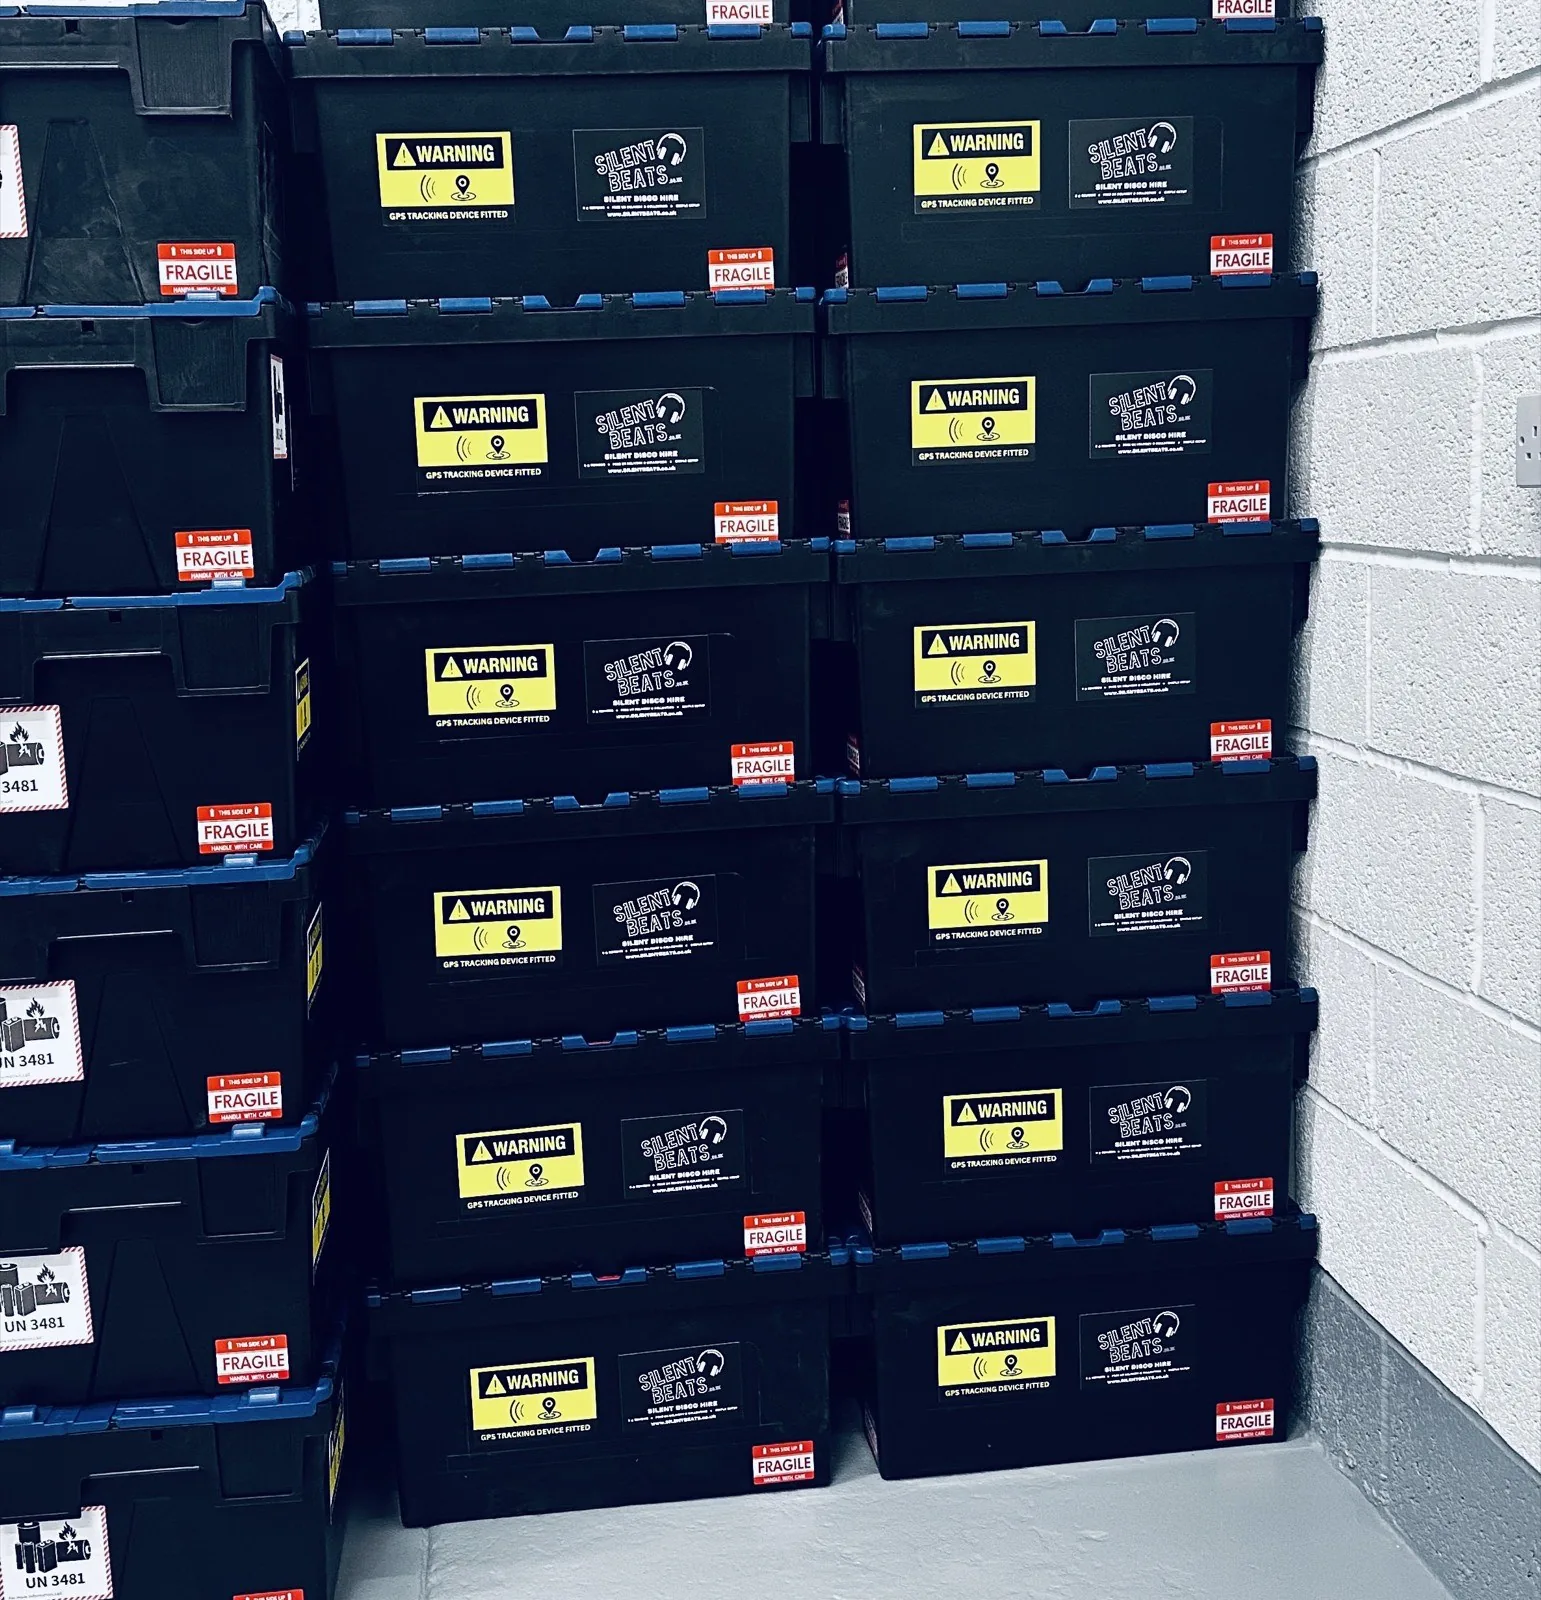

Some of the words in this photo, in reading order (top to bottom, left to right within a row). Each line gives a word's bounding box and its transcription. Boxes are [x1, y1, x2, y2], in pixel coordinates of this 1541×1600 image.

[712, 5, 769, 19] FRAGILE
[1218, 0, 1272, 13] FRAGILE
[950, 133, 1024, 152] WARNING
[416, 144, 495, 162] WARNING
[1101, 153, 1158, 180] BEATS
[608, 165, 668, 192] BEATS
[921, 200, 937, 208] GPS
[938, 199, 977, 207] TRACKING
[978, 198, 1006, 206] DEVICE
[1007, 197, 1033, 205] FITTED
[389, 212, 406, 220] GPS
[407, 212, 448, 220] TRACKING
[450, 211, 479, 219] DEVICE
[480, 210, 508, 218] FITTED
[1216, 253, 1269, 267] FRAGILE
[166, 265, 233, 280] FRAGILE
[714, 267, 770, 282] FRAGILE
[947, 388, 1019, 406] WARNING
[452, 406, 529, 424] WARNING
[1121, 404, 1177, 431] BEATS
[609, 423, 668, 450] BEATS
[1143, 432, 1167, 440] DISCO
[1168, 431, 1186, 439] HIRE
[919, 452, 934, 460] GPS
[935, 451, 973, 459] TRACKING
[974, 450, 1002, 458] DEVICE
[1003, 449, 1028, 457] FITTED
[426, 471, 442, 479] GPS
[443, 470, 483, 478] TRACKING
[485, 469, 513, 477] DEVICE
[515, 468, 541, 476] FITTED
[1213, 498, 1266, 513] FRAGILE
[720, 519, 775, 533] FRAGILE
[183, 551, 249, 566] FRAGILE
[949, 632, 1020, 651] WARNING
[463, 656, 538, 674] WARNING
[1106, 647, 1162, 674] BEATS
[617, 670, 675, 696] BEATS
[1129, 674, 1152, 682] DISCO
[641, 697, 665, 705] DISCO
[937, 693, 975, 701] TRACKING
[976, 692, 1003, 700] DEVICE
[1004, 690, 1029, 698] FITTED
[436, 719, 452, 727] GPS
[453, 718, 492, 726] TRACKING
[494, 716, 522, 725] DEVICE
[523, 715, 550, 723] FITTED
[1216, 737, 1268, 751] FRAGILE
[737, 759, 791, 774] FRAGILE
[2, 779, 38, 793] 3481
[204, 823, 269, 839] FRAGILE
[962, 871, 1032, 889] WARNING
[1119, 884, 1174, 910] BEATS
[471, 897, 545, 916] WARNING
[1114, 912, 1140, 920] SILENT
[1141, 910, 1164, 918] DISCO
[626, 910, 683, 937] BEATS
[951, 930, 988, 939] TRACKING
[990, 929, 1016, 937] DEVICE
[1017, 927, 1042, 935] FITTED
[443, 960, 459, 968] GPS
[460, 958, 499, 967] TRACKING
[500, 957, 528, 965] DEVICE
[529, 955, 556, 963] FITTED
[1216, 968, 1267, 983] FRAGILE
[743, 992, 797, 1009] FRAGILE
[0, 1056, 14, 1068] N
[19, 1053, 54, 1067] 3481
[214, 1092, 278, 1109] FRAGILE
[978, 1099, 1047, 1118] WARNING
[1120, 1113, 1174, 1138] BEATS
[493, 1135, 566, 1156] WARNING
[1115, 1140, 1140, 1148] SILENT
[654, 1144, 710, 1171] BEATS
[967, 1159, 1003, 1167] TRACKING
[1005, 1157, 1031, 1165] DEVICE
[1032, 1155, 1057, 1163] FITTED
[467, 1201, 483, 1209] GPS
[484, 1197, 522, 1207] TRACKING
[524, 1194, 551, 1203] DEVICE
[552, 1191, 578, 1200] FITTED
[1220, 1194, 1270, 1209] FRAGILE
[749, 1229, 802, 1244] FRAGILE
[5, 1320, 26, 1332] UN
[31, 1317, 65, 1330] 3481
[971, 1327, 1040, 1347] WARNING
[1109, 1338, 1163, 1363] BEATS
[223, 1354, 285, 1371] FRAGILE
[506, 1369, 579, 1390] WARNING
[652, 1377, 708, 1404] BEATS
[961, 1386, 997, 1395] TRACKING
[998, 1383, 1024, 1392] DEVICE
[1025, 1381, 1049, 1389] FITTED
[647, 1405, 674, 1414] SILENT
[675, 1403, 699, 1411] DISCO
[700, 1400, 718, 1408] HIRE
[1221, 1415, 1270, 1429] FRAGILE
[481, 1433, 496, 1441] GPS
[497, 1429, 535, 1439] TRACKING
[536, 1427, 564, 1436] DEVICE
[565, 1424, 591, 1433] FITTED
[758, 1457, 811, 1473] FRAGILE
[26, 1576, 47, 1588] UN
[52, 1573, 85, 1586] 3481
